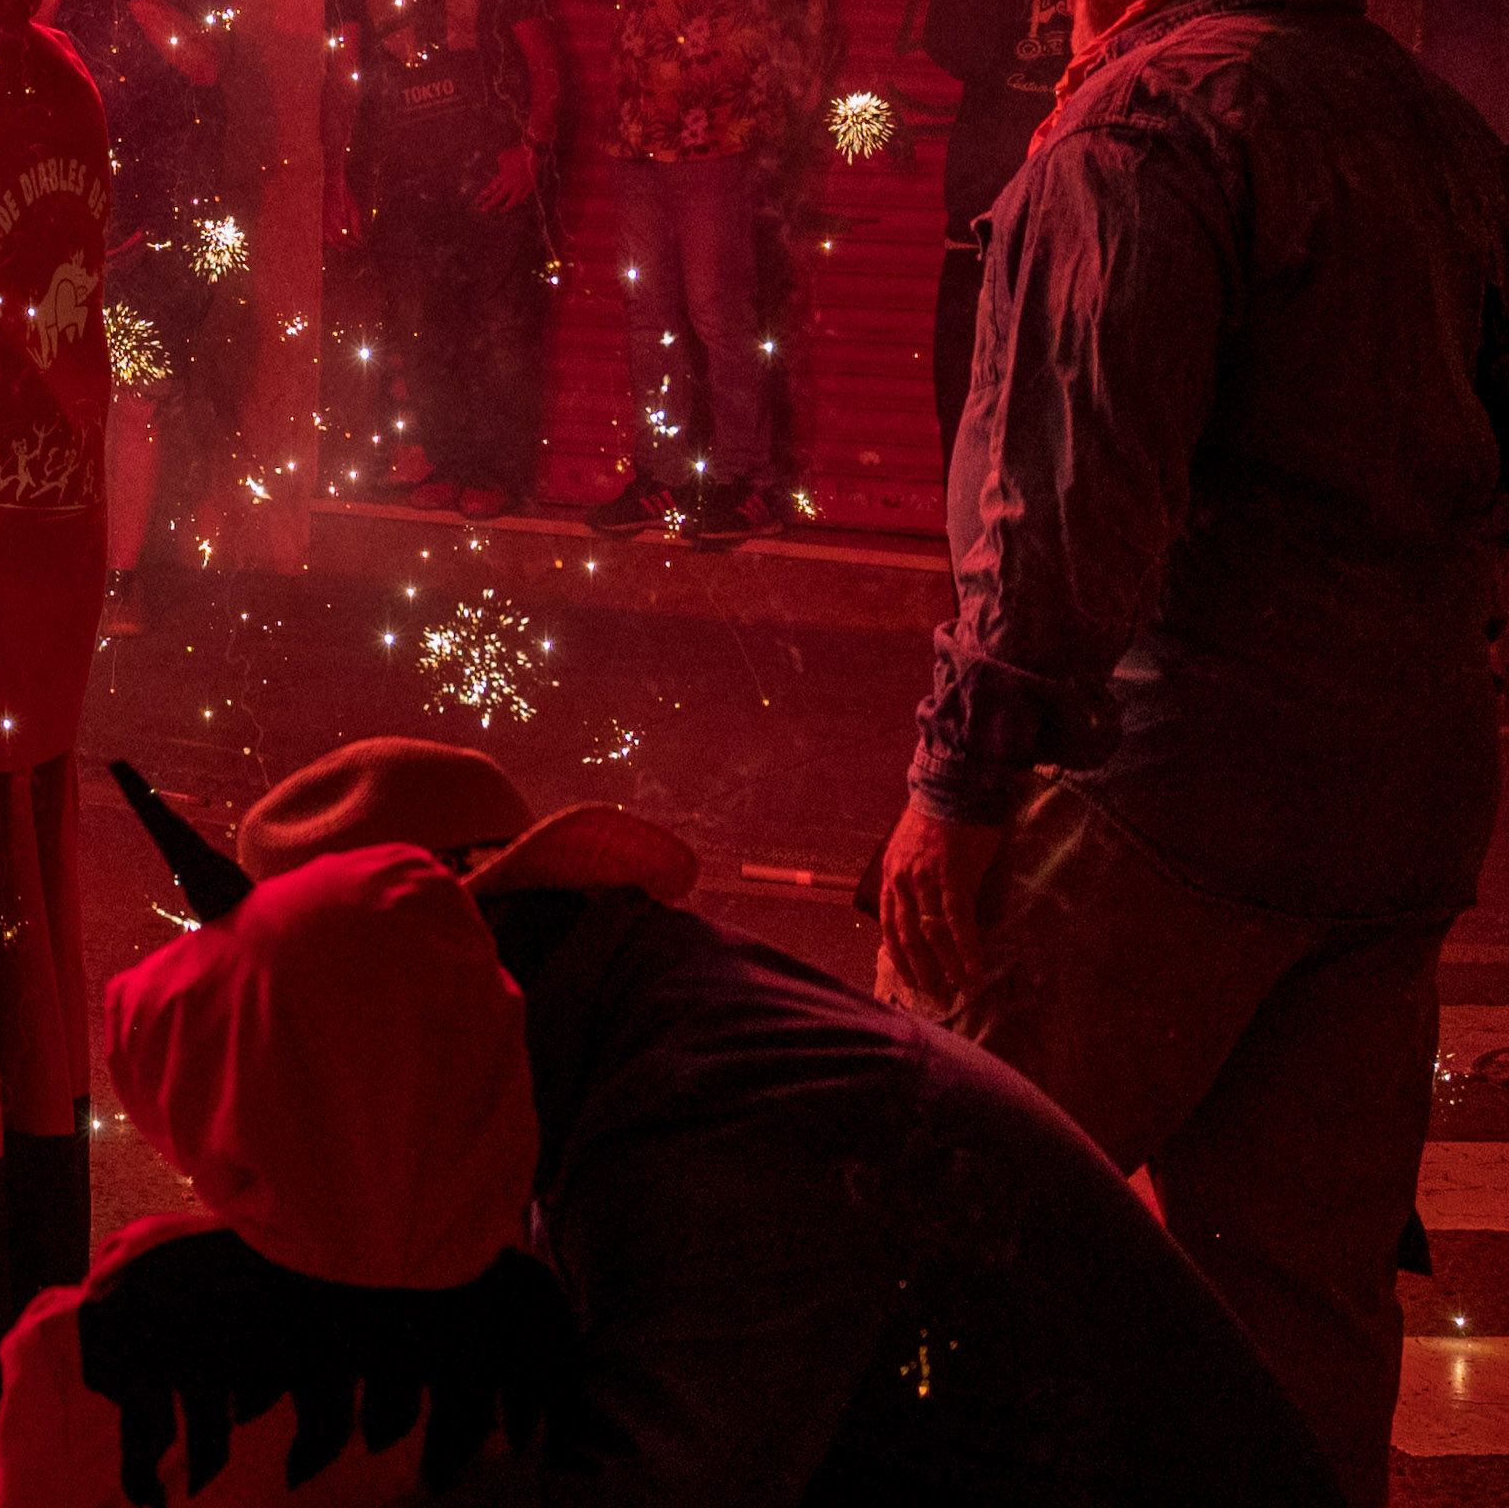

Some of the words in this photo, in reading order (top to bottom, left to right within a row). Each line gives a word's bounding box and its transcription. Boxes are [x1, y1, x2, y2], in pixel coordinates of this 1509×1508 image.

[402, 78, 455, 105] TOKYO
[19, 158, 87, 207] DIABLES
[88, 178, 107, 220] DE
